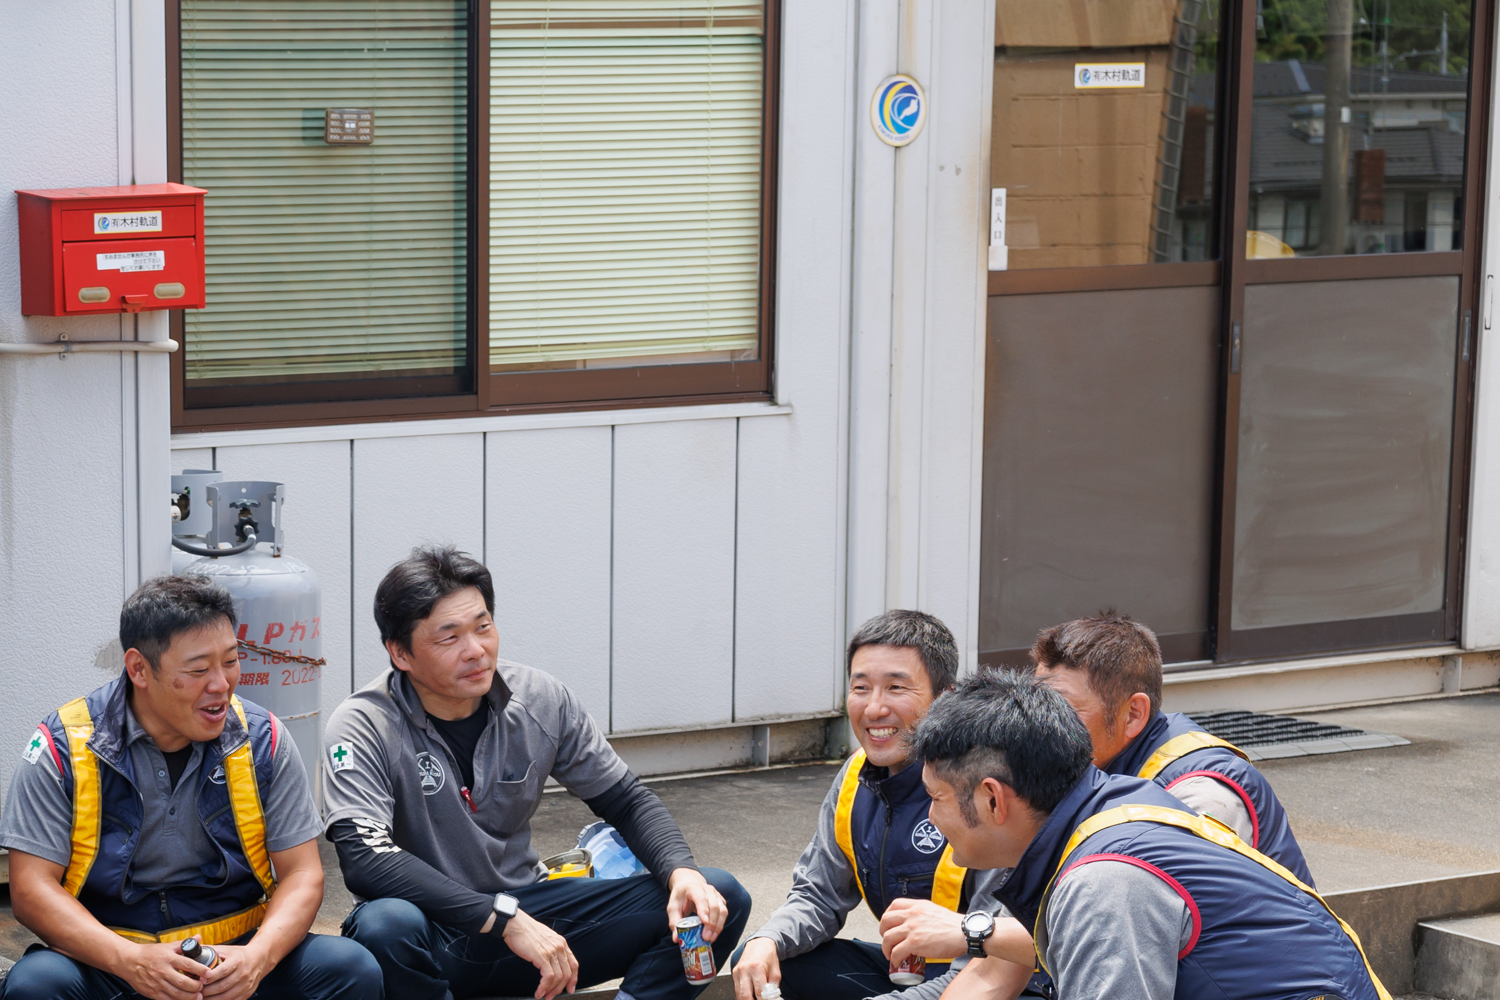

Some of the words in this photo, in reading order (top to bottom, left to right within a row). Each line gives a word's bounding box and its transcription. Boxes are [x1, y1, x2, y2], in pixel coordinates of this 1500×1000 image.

[994, 195, 1003, 240] 出入口
[237, 616, 320, 647] LPガス
